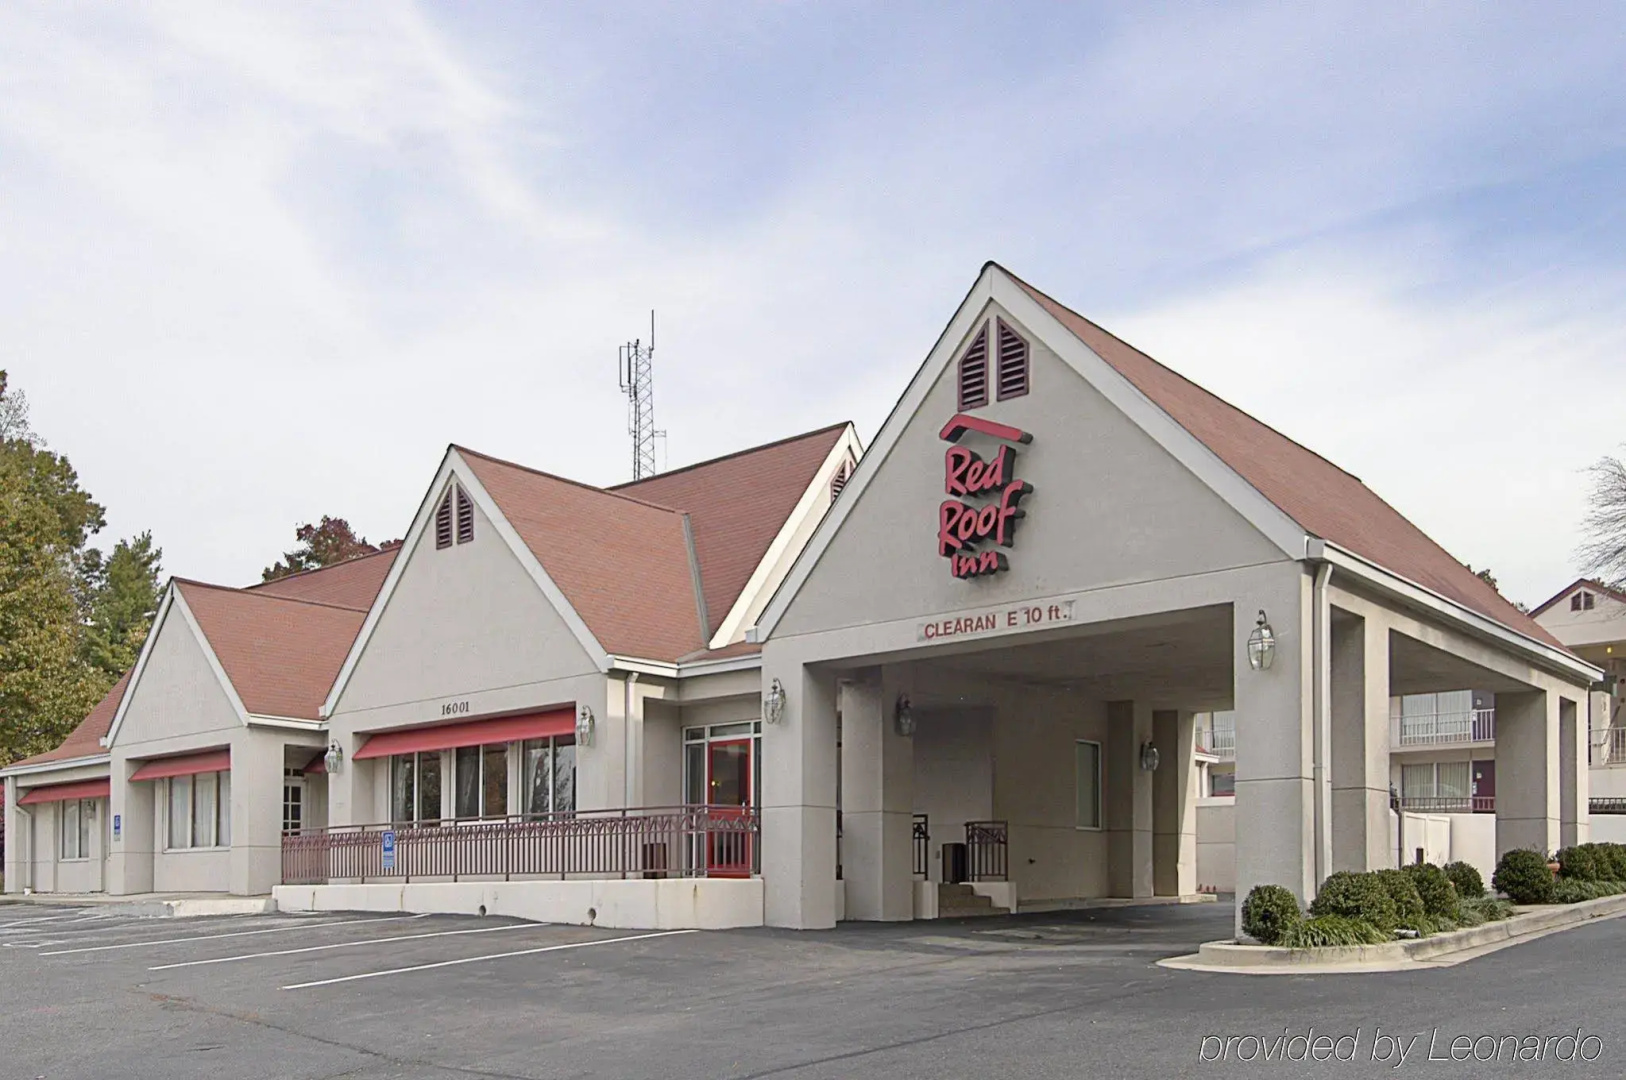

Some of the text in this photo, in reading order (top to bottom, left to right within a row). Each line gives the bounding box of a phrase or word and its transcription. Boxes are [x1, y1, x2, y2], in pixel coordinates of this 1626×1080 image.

[945, 444, 1012, 496] Red
[938, 479, 1030, 556] Roof
[951, 550, 1005, 579] Inn
[1023, 606, 1042, 624] 10
[1047, 604, 1067, 621] ft.
[441, 701, 469, 715] 16001
